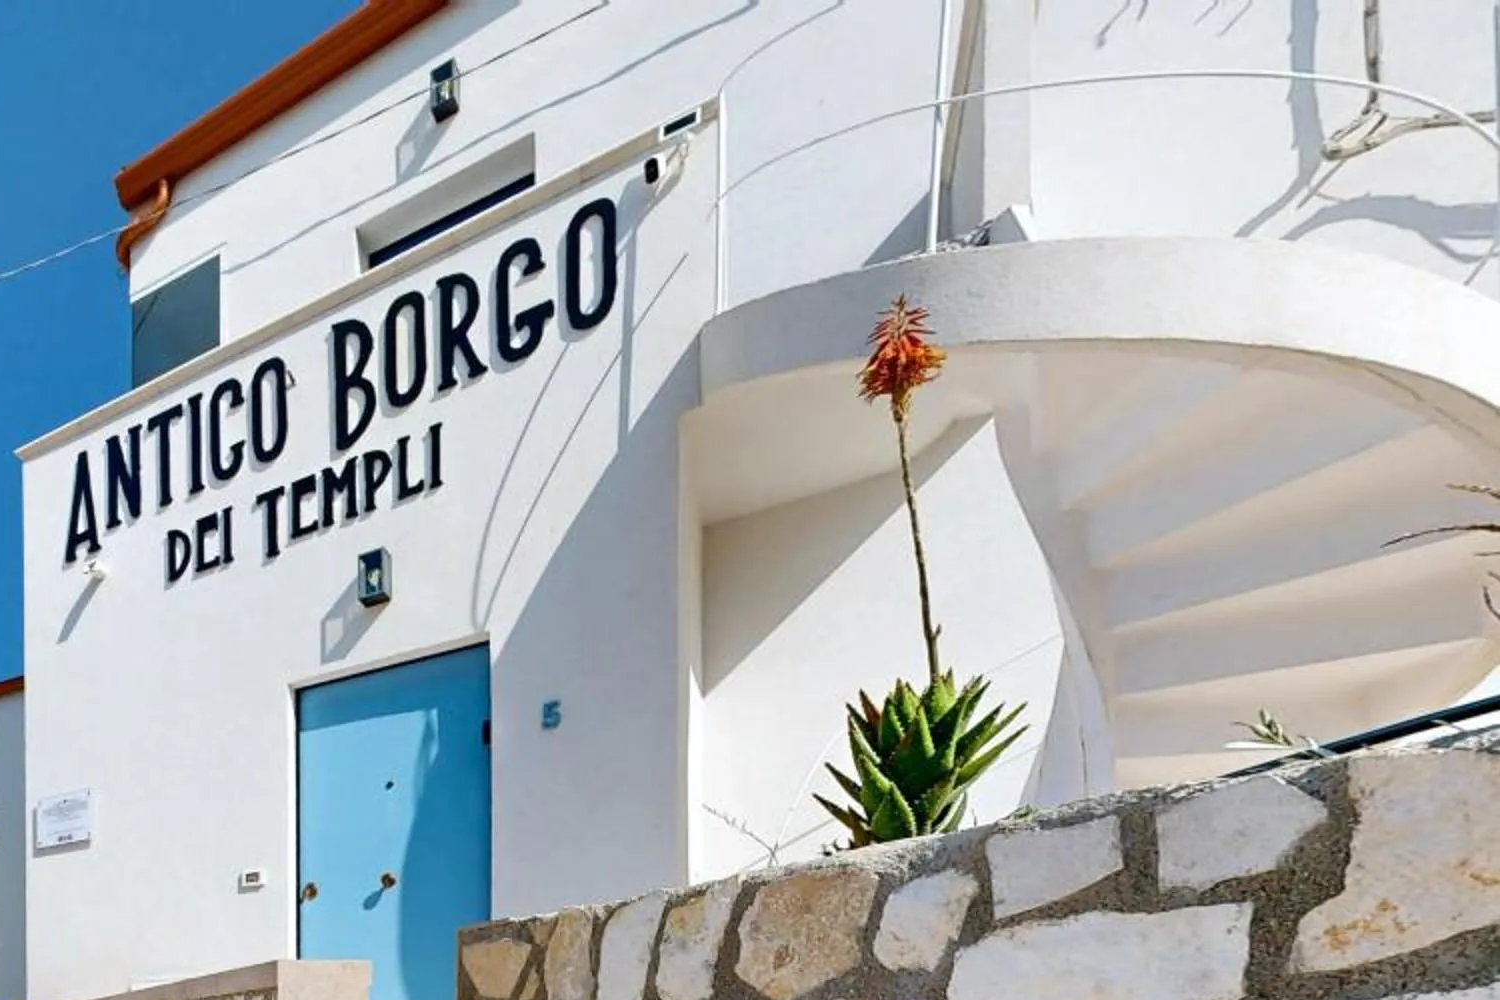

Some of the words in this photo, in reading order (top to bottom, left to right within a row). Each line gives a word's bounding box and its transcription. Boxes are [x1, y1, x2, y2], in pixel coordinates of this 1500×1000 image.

[63, 356, 291, 563] ANTICO
[330, 198, 618, 452] BORGO
[166, 506, 234, 583] DEI
[255, 422, 444, 558] TEMPLI
[541, 700, 561, 730] 5
